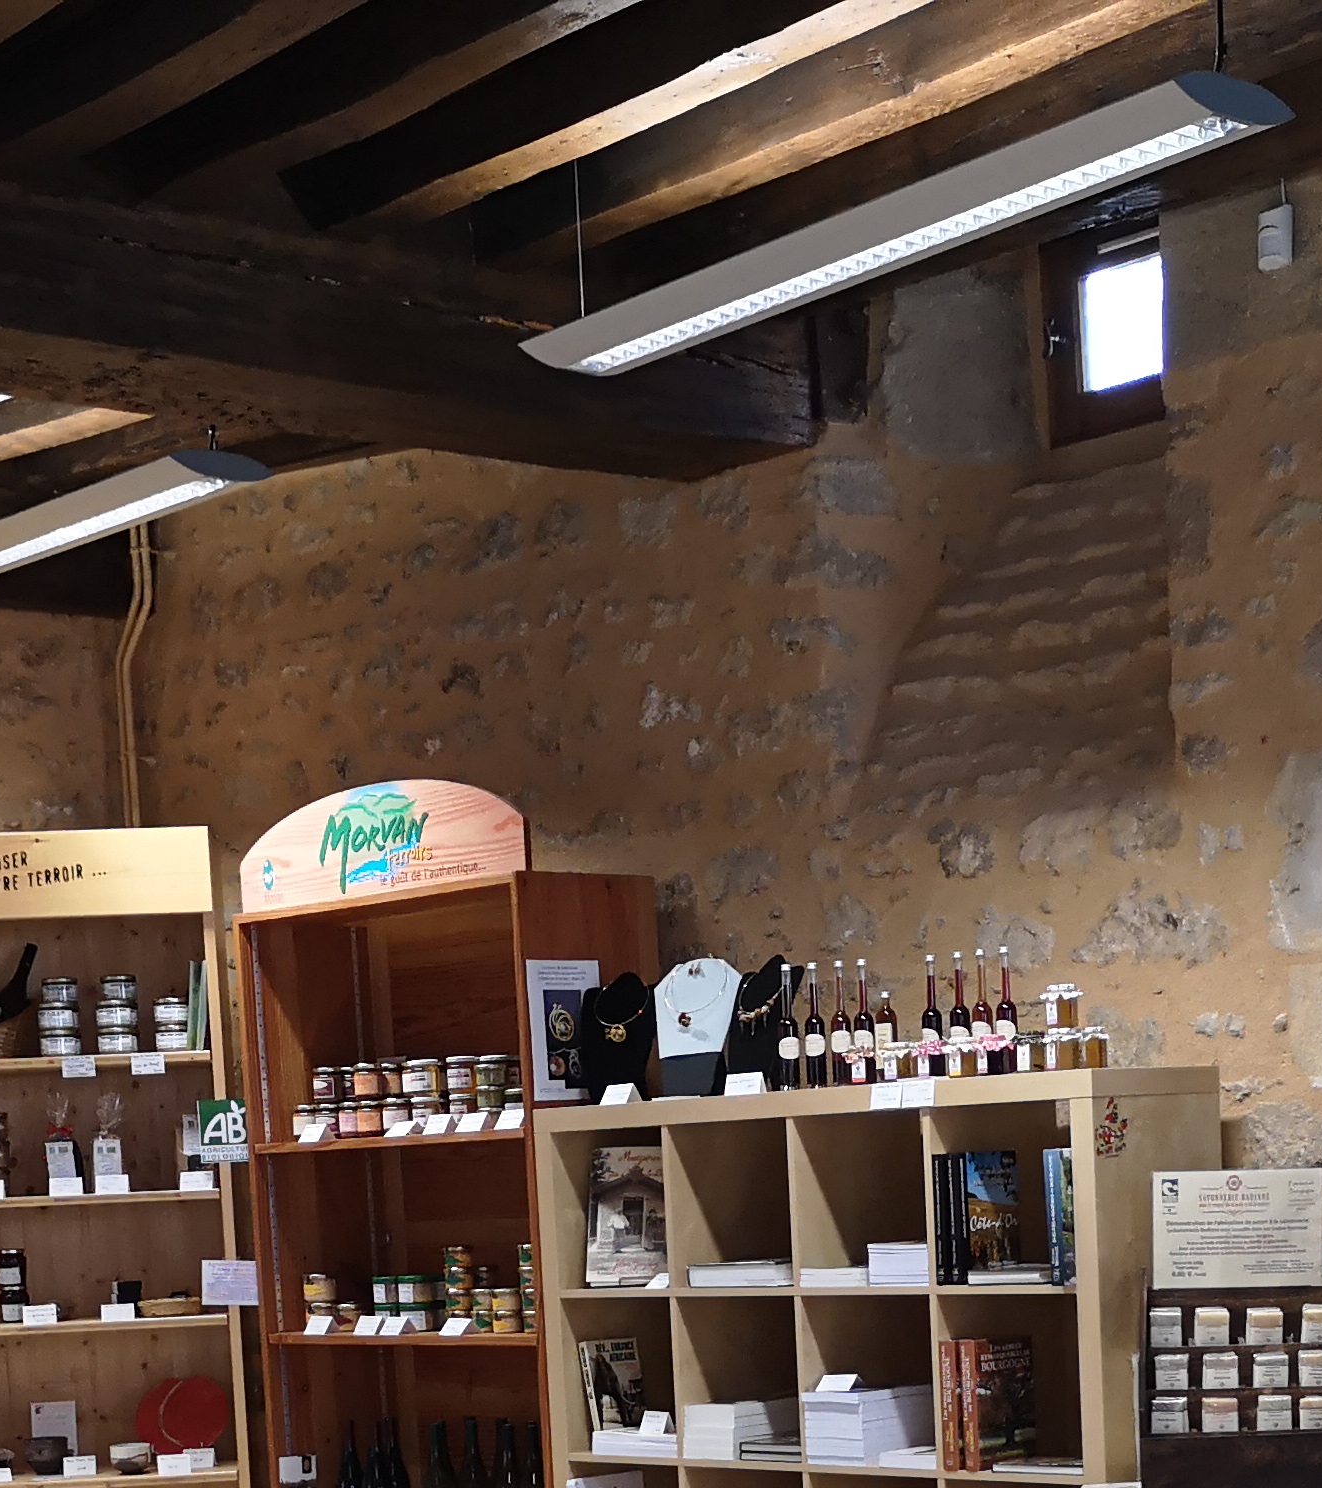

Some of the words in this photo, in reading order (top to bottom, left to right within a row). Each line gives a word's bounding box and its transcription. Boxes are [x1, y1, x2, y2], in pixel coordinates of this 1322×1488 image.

[319, 811, 430, 894] MORVAN
[27, 863, 84, 888] TERROIR
[203, 1104, 247, 1144] AB
[981, 1357, 1031, 1372] BOURGOGNE
